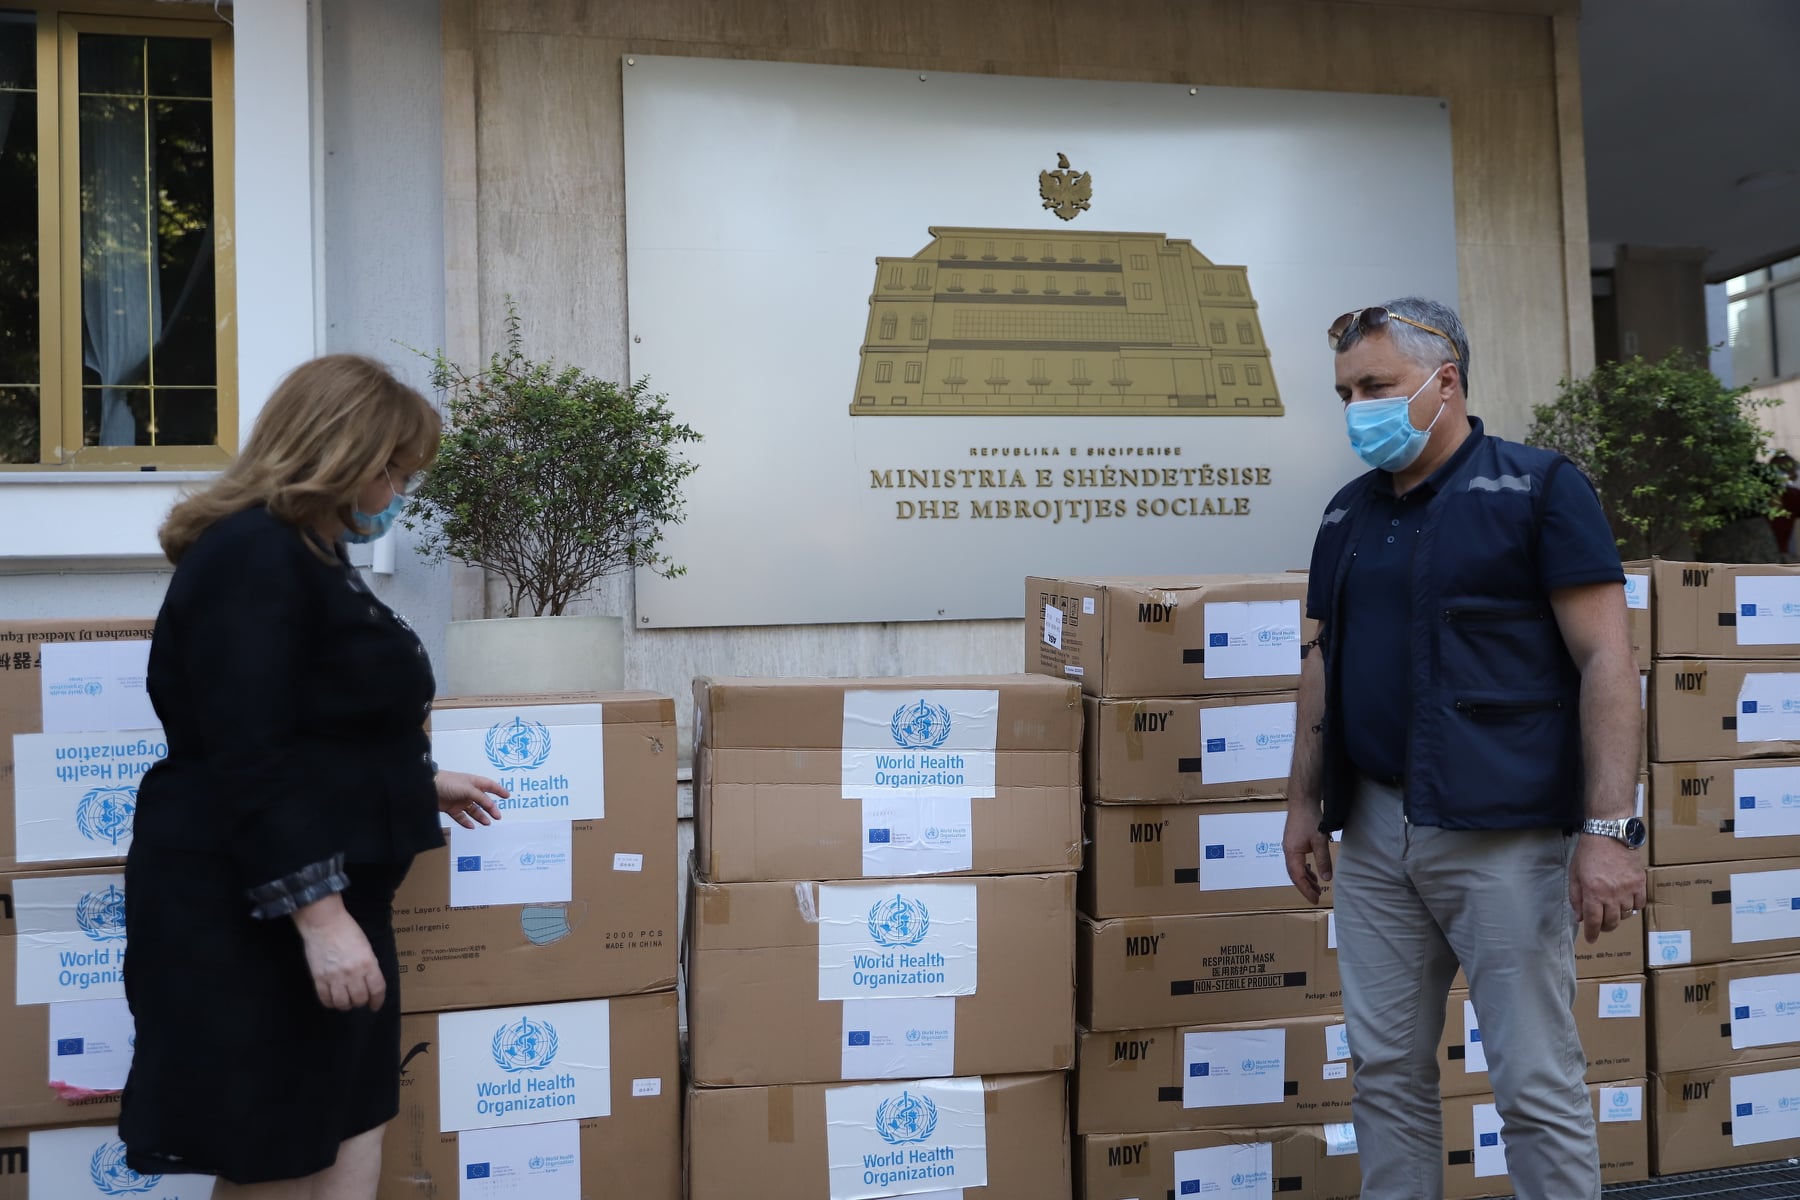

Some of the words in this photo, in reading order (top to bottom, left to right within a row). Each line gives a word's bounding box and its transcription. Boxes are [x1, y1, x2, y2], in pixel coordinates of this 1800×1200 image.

[970, 447, 1060, 457] REPUBLIKA
[1070, 447, 1077, 456] E
[1087, 447, 1182, 457] SHQIPERISE
[870, 469, 1027, 489] MINISTRIA
[1035, 469, 1054, 488] E
[896, 500, 960, 520] DHE
[970, 498, 1127, 524] MBROJTJES
[1136, 497, 1251, 518] SOCIALE
[28, 631, 76, 643] Medical
[56, 739, 168, 763] Organization
[875, 754, 915, 769] World
[920, 754, 964, 769] Health
[56, 763, 112, 783] Health
[118, 762, 154, 780] orld
[875, 771, 964, 788] Organization
[520, 774, 568, 792] Health
[496, 793, 569, 810] anization
[394, 923, 450, 934] poallergenic
[606, 931, 634, 940] 2000
[640, 930, 663, 938] PCS
[605, 941, 625, 949] MADE
[628, 941, 637, 949] IN
[640, 940, 663, 948] CHINA
[1220, 944, 1254, 955] MEDICAL
[60, 948, 109, 967] World
[853, 953, 894, 970] World
[900, 952, 944, 968] Health
[1202, 954, 1250, 967] RESPIRATOR
[1252, 953, 1275, 963] MASK
[59, 966, 125, 989] Organiz
[853, 970, 945, 989] Organization
[1212, 964, 1266, 977] 医用防护口罩
[1195, 978, 1246, 992] NON-STERILE
[1248, 975, 1282, 988] PRODUCT
[477, 1078, 521, 1098] World
[527, 1073, 575, 1092] Health
[477, 1092, 575, 1116] Organization
[863, 1152, 904, 1169] World
[909, 1146, 954, 1164] Health
[863, 1164, 955, 1186] Organization
